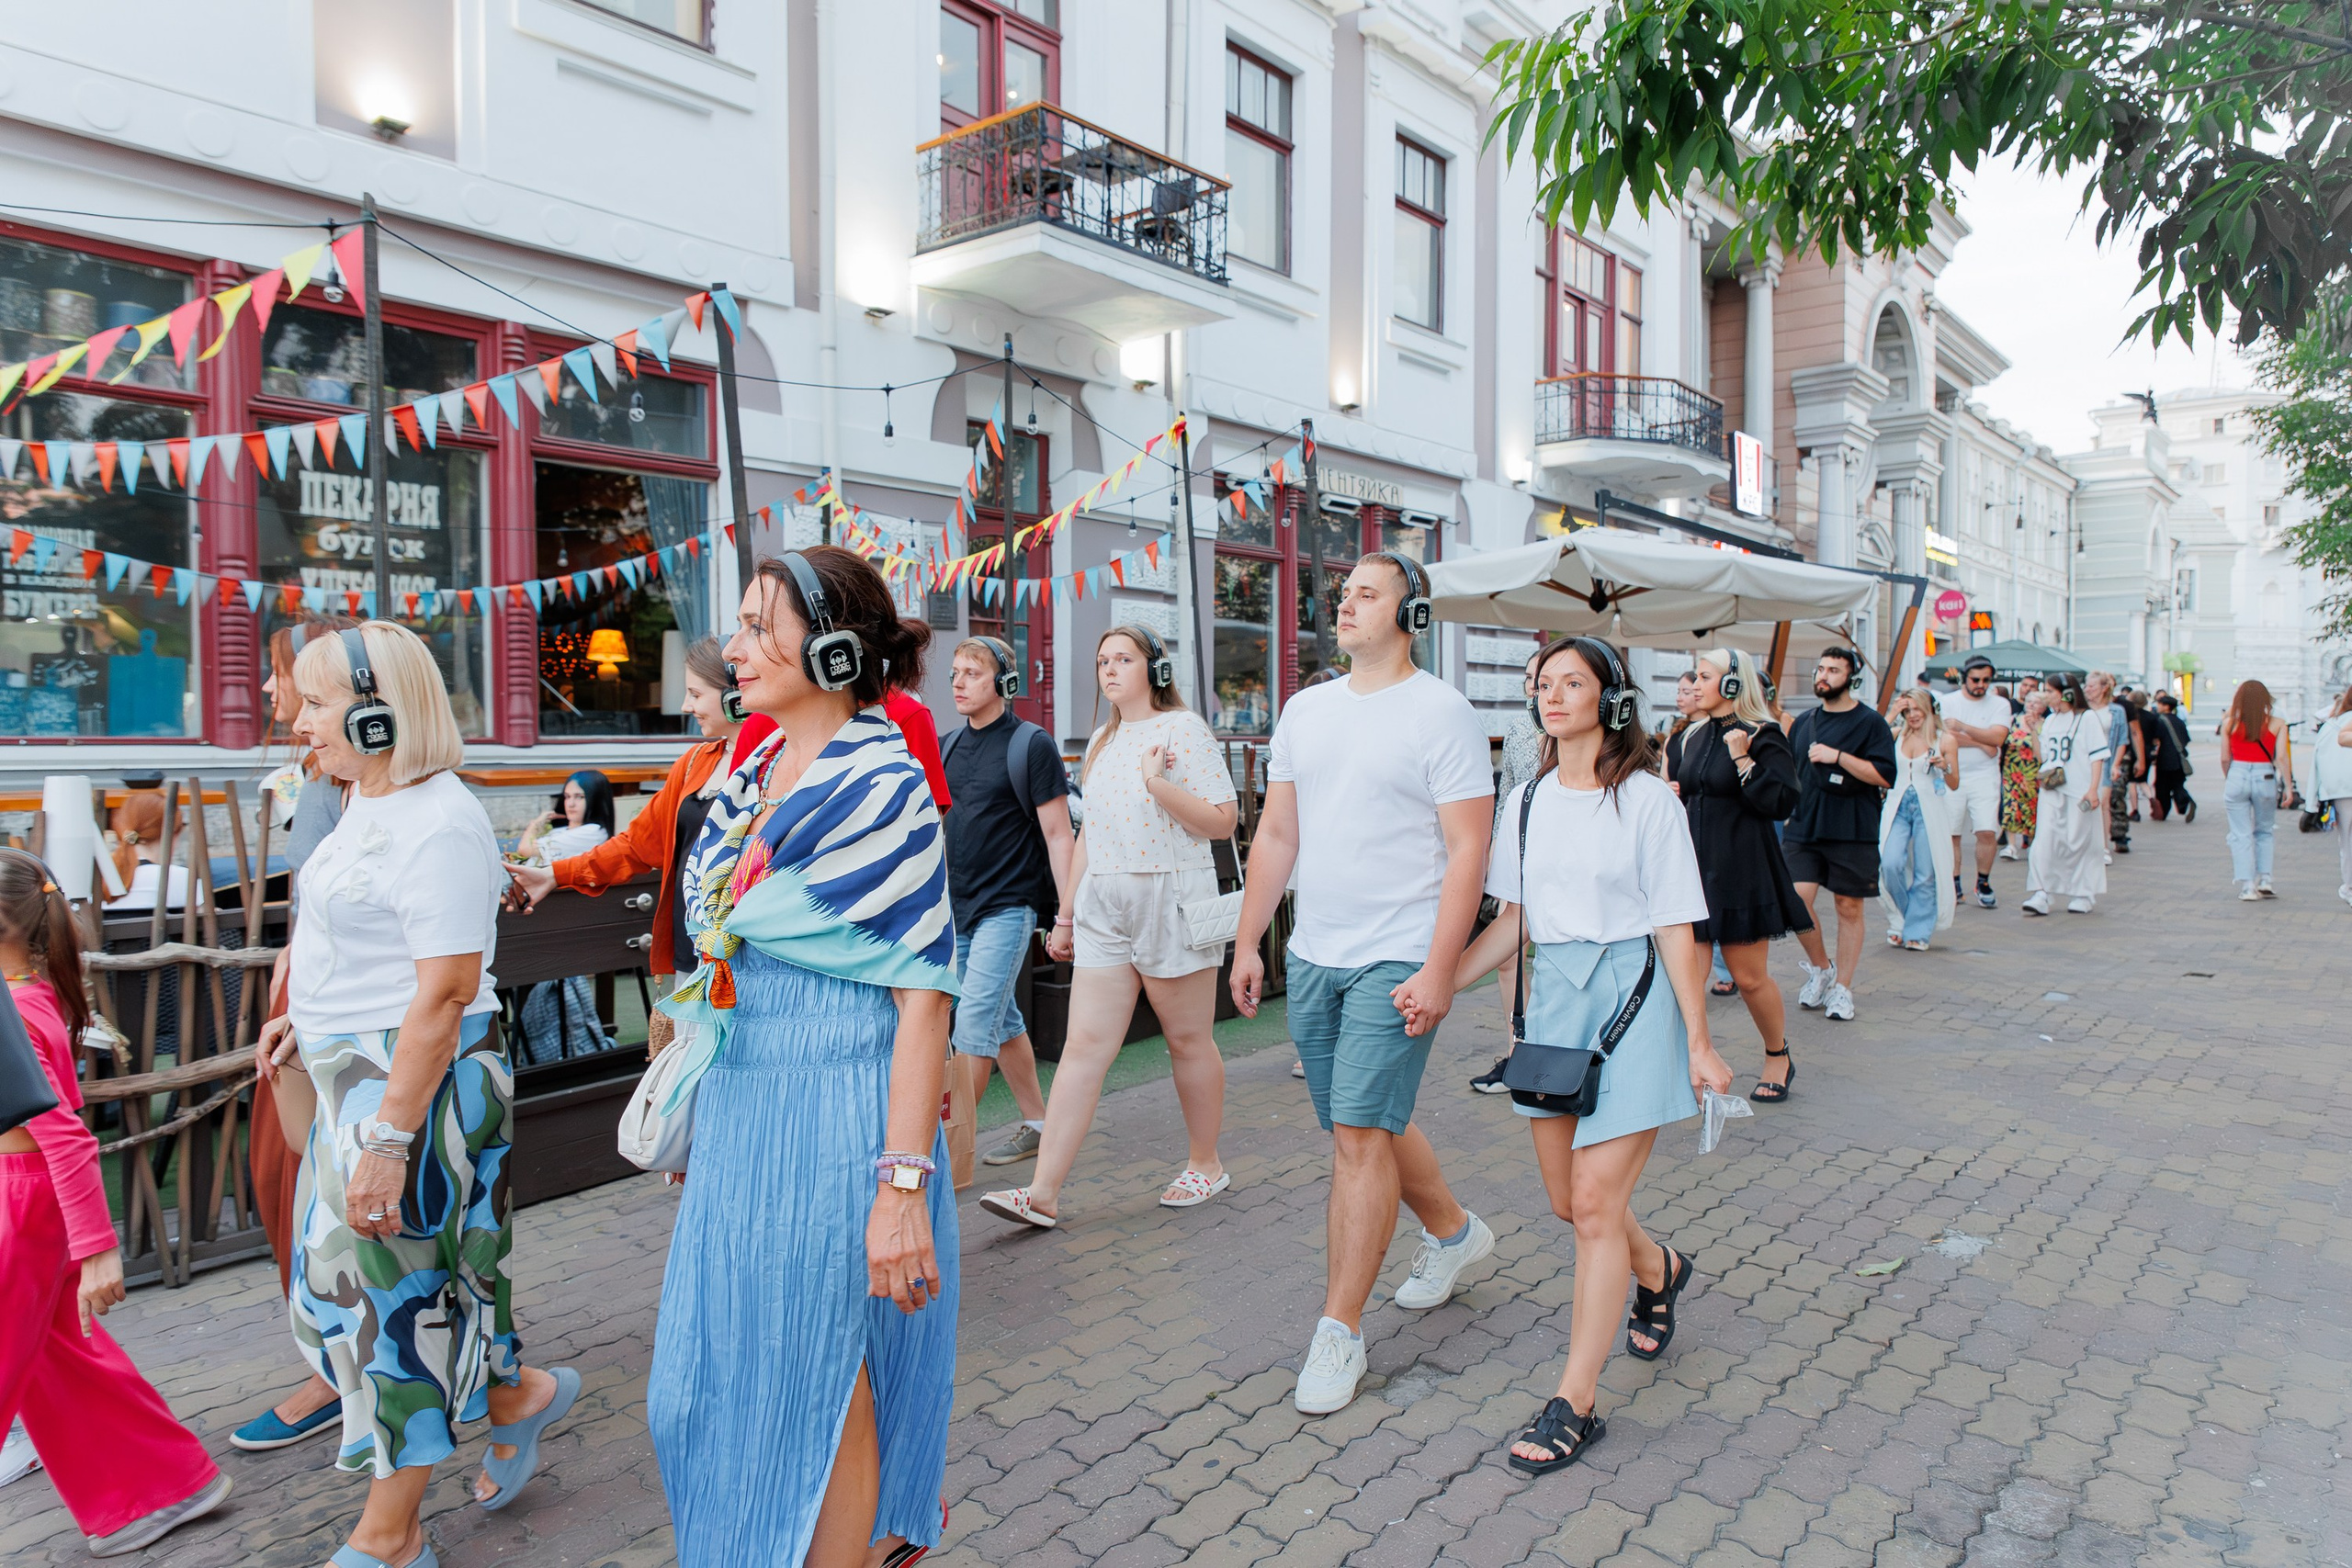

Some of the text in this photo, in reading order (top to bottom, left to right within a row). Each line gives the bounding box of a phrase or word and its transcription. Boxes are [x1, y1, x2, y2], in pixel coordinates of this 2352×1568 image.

[830, 661, 851, 671] ГОЛОС
[1608, 995, 1641, 1043] Calvin Klein
